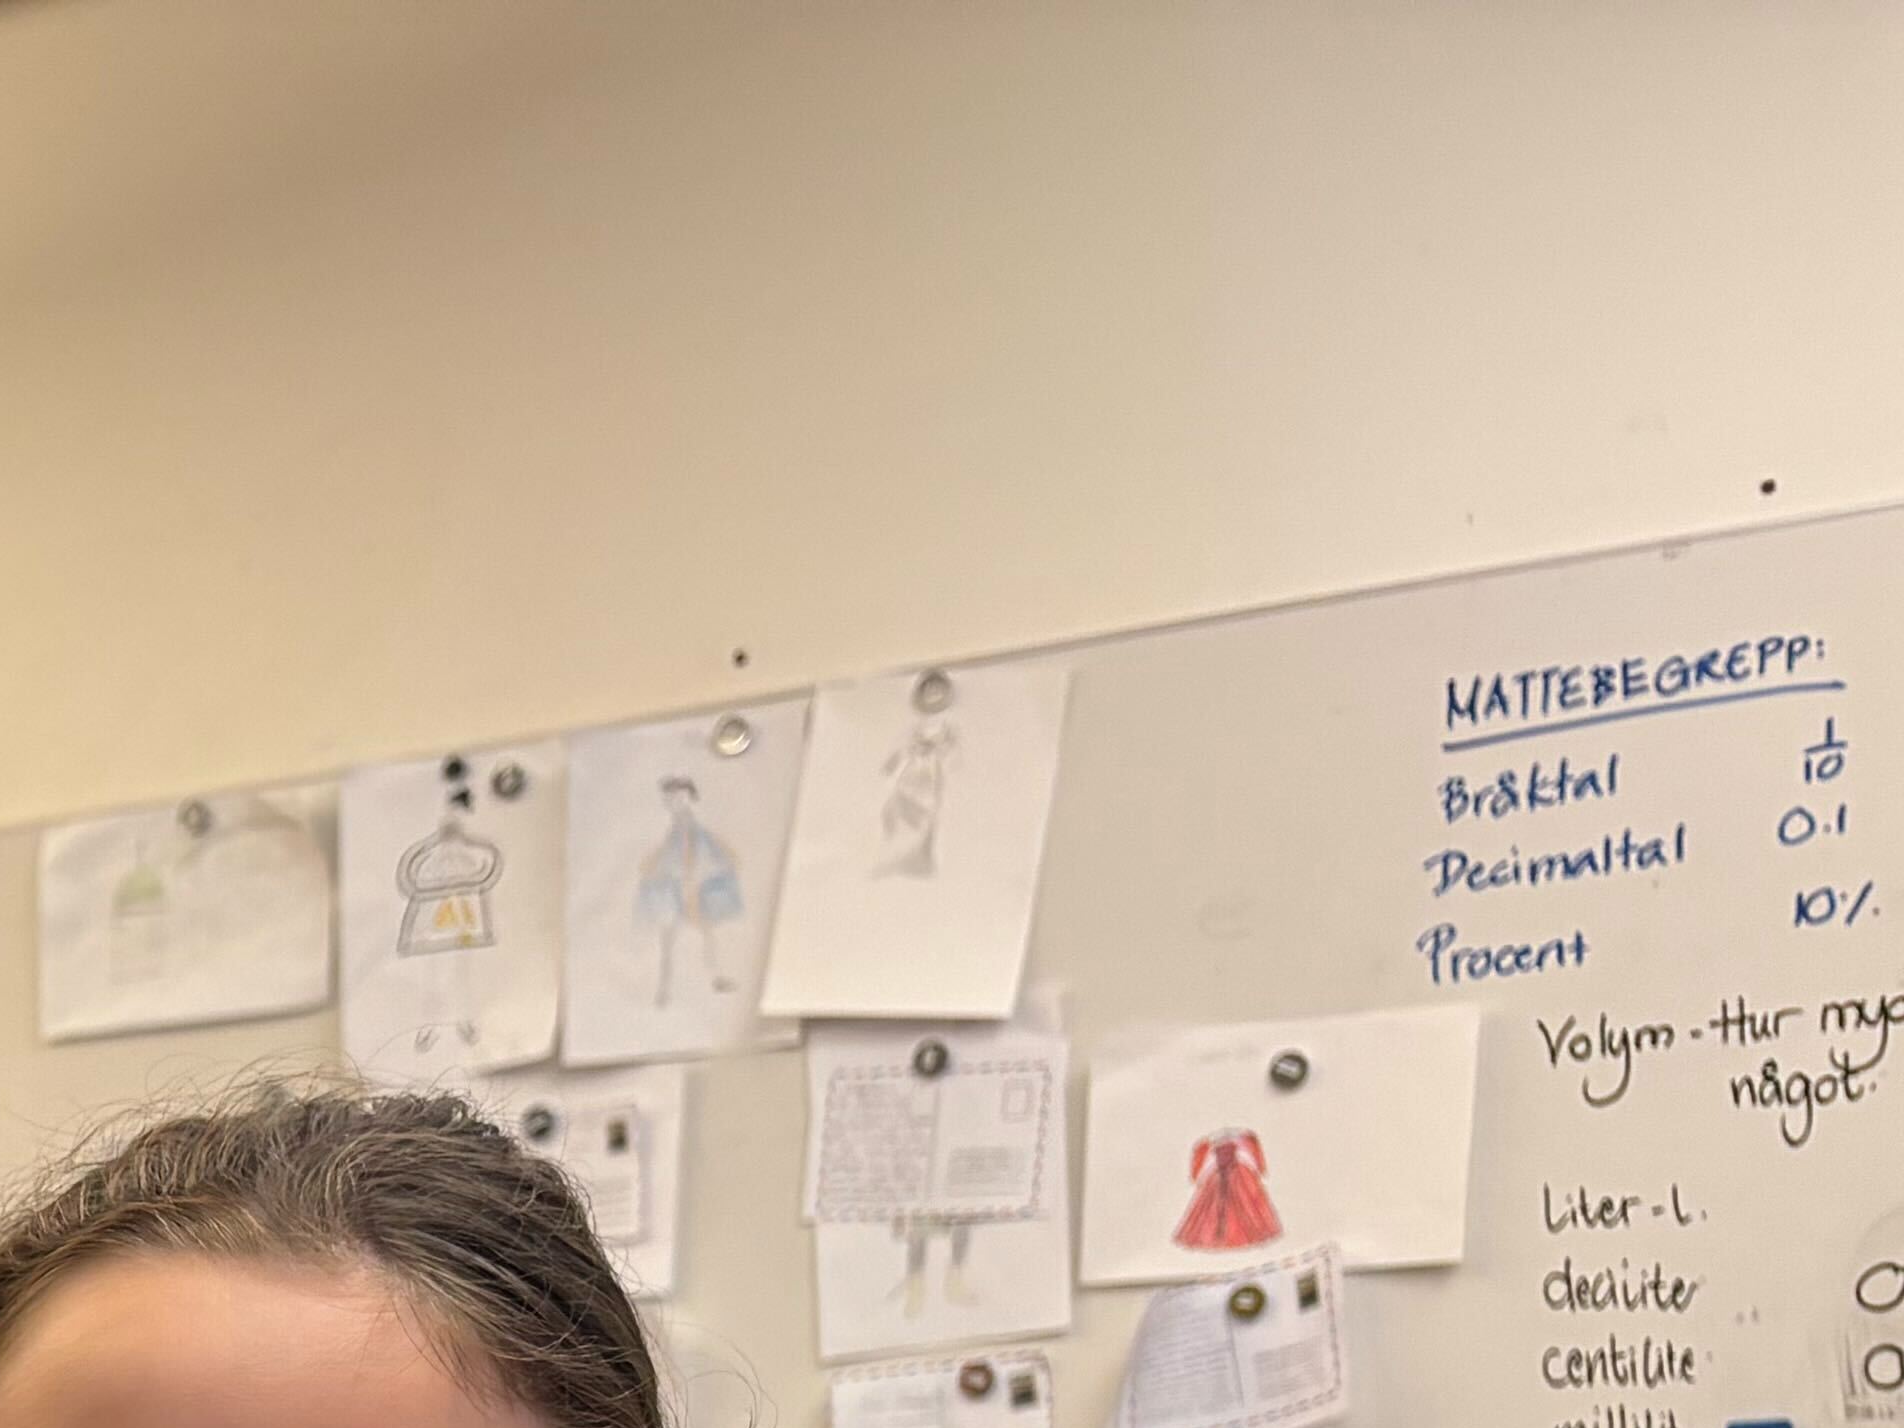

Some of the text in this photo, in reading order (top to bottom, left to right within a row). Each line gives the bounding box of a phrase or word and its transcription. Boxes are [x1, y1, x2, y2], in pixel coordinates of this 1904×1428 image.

[1446, 635, 1826, 731] MATTEBEGREPP:
[1438, 753, 1620, 825] Bråktal
[1423, 821, 1685, 898] Decimaltal
[1415, 922, 1589, 986] Procent
[1536, 1011, 1675, 1107] Volym
[1709, 993, 1803, 1046] Hur
